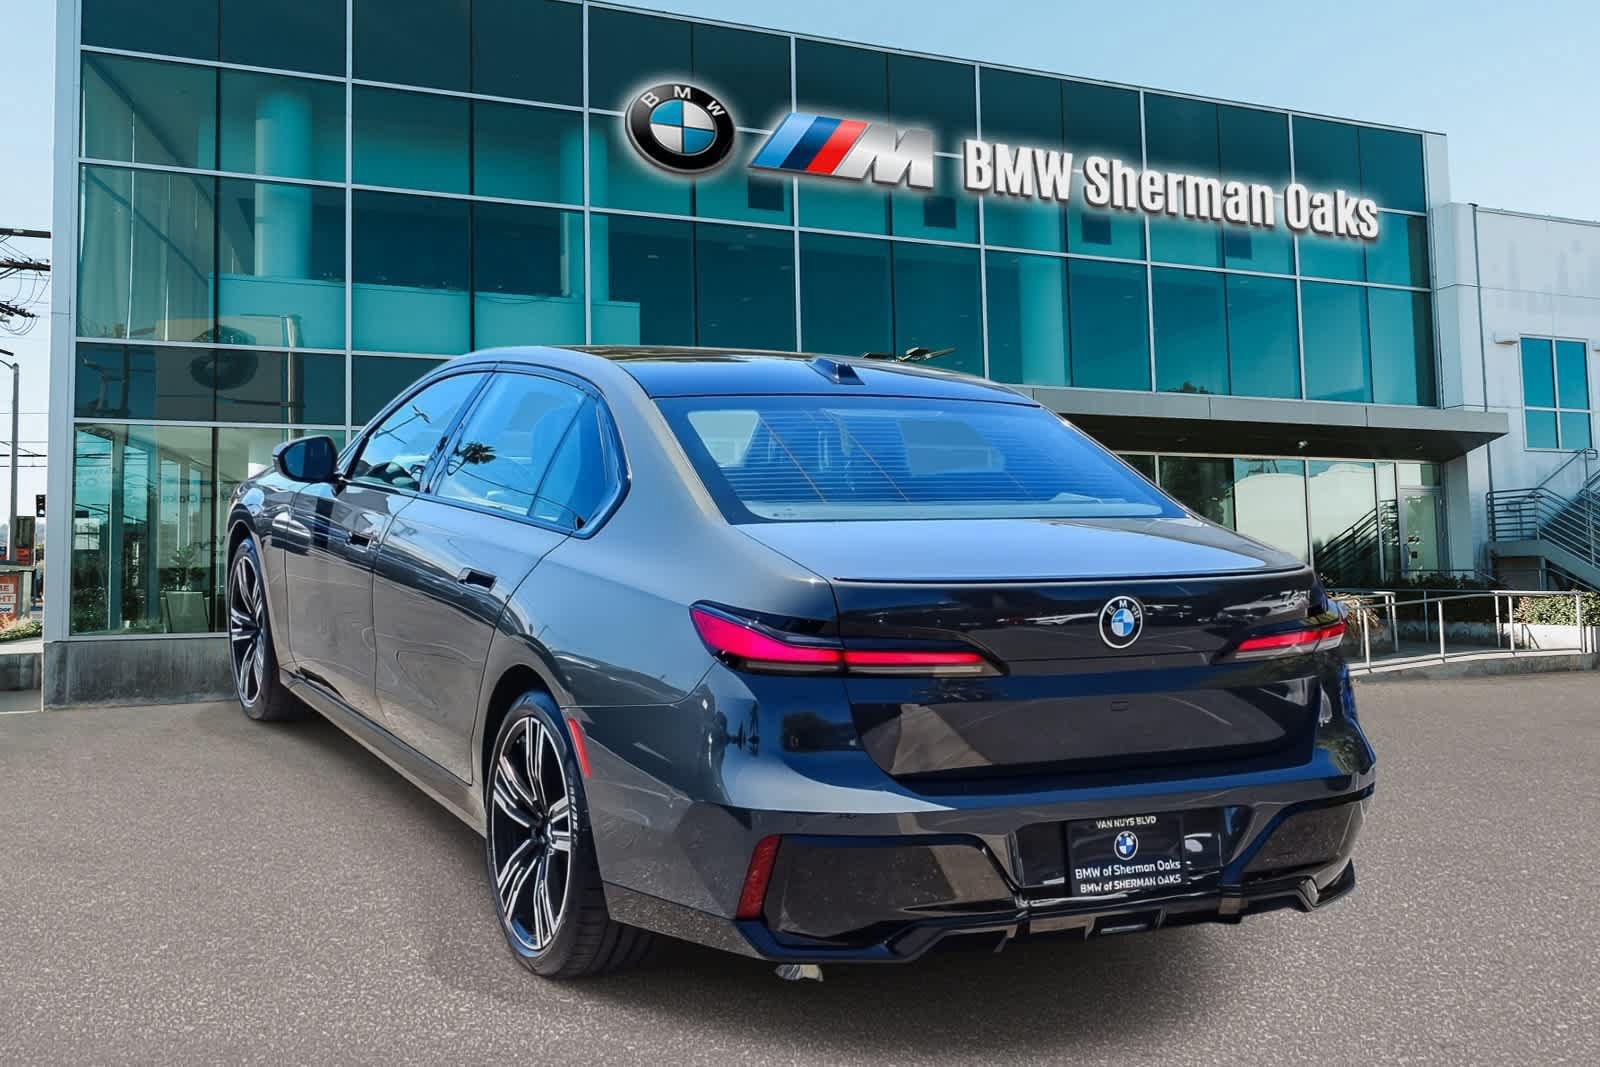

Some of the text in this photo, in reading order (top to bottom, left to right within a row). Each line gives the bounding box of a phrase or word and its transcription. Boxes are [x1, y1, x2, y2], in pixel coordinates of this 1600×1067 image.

[641, 85, 726, 118] BMW
[963, 138, 1380, 241] BMW Sherman Oaks
[1107, 599, 1141, 619] BMW
[1096, 815, 1157, 829] VAN NUYS BLVD
[1075, 859, 1181, 880] BMW of Sherman Oaks
[1080, 874, 1182, 893] BMW of SHERMAN OAKS
